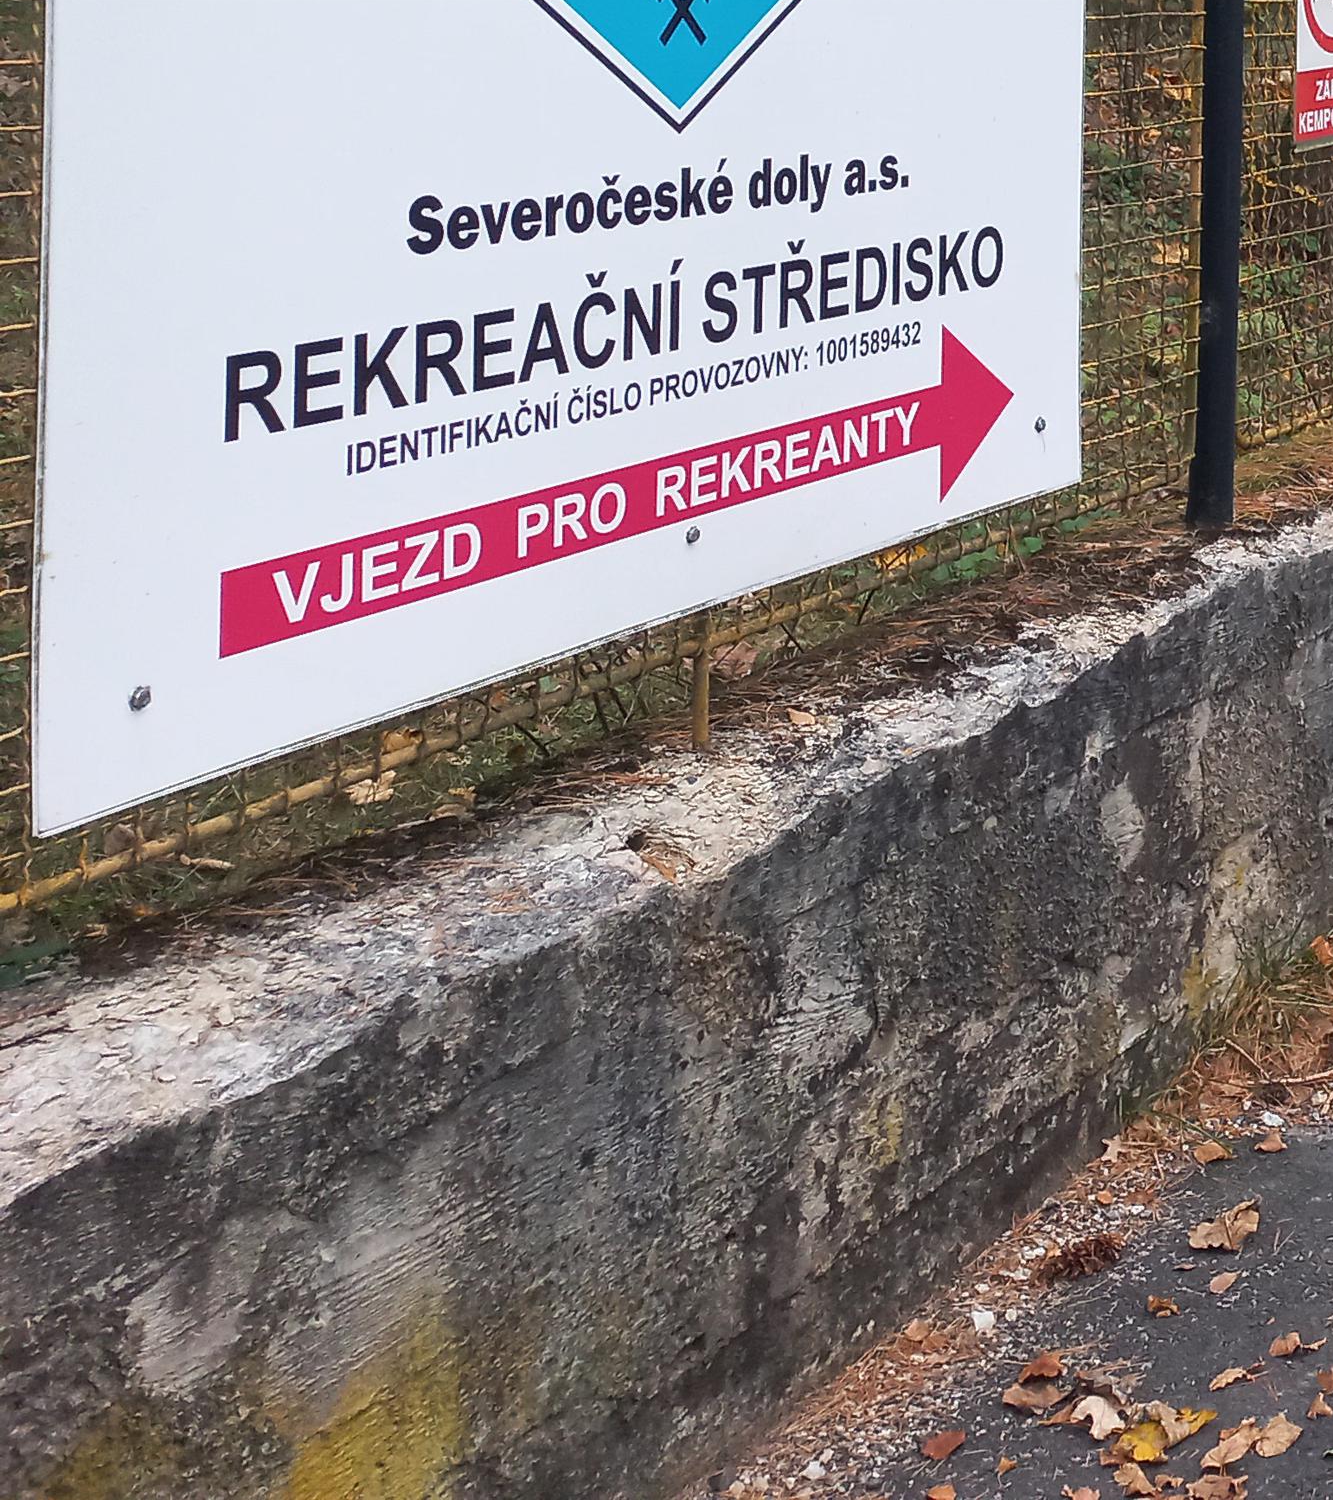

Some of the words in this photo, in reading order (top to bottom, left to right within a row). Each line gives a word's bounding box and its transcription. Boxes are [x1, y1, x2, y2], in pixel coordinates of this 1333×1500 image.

[407, 157, 733, 254] Severočeské
[749, 153, 831, 212] doly
[844, 155, 909, 196] a.s.
[224, 258, 683, 442] REKREAČNÍ
[702, 226, 1004, 344] STŘEDISKO
[346, 391, 560, 475] IDENTIFIKAČNÍ
[567, 381, 642, 425] ČÍSLO
[650, 345, 810, 405] PROVOZOVNY:
[816, 322, 921, 367] 1001589432
[273, 522, 482, 624] VJEZD
[517, 482, 626, 559] PRO
[656, 401, 920, 517] REKREANTY
